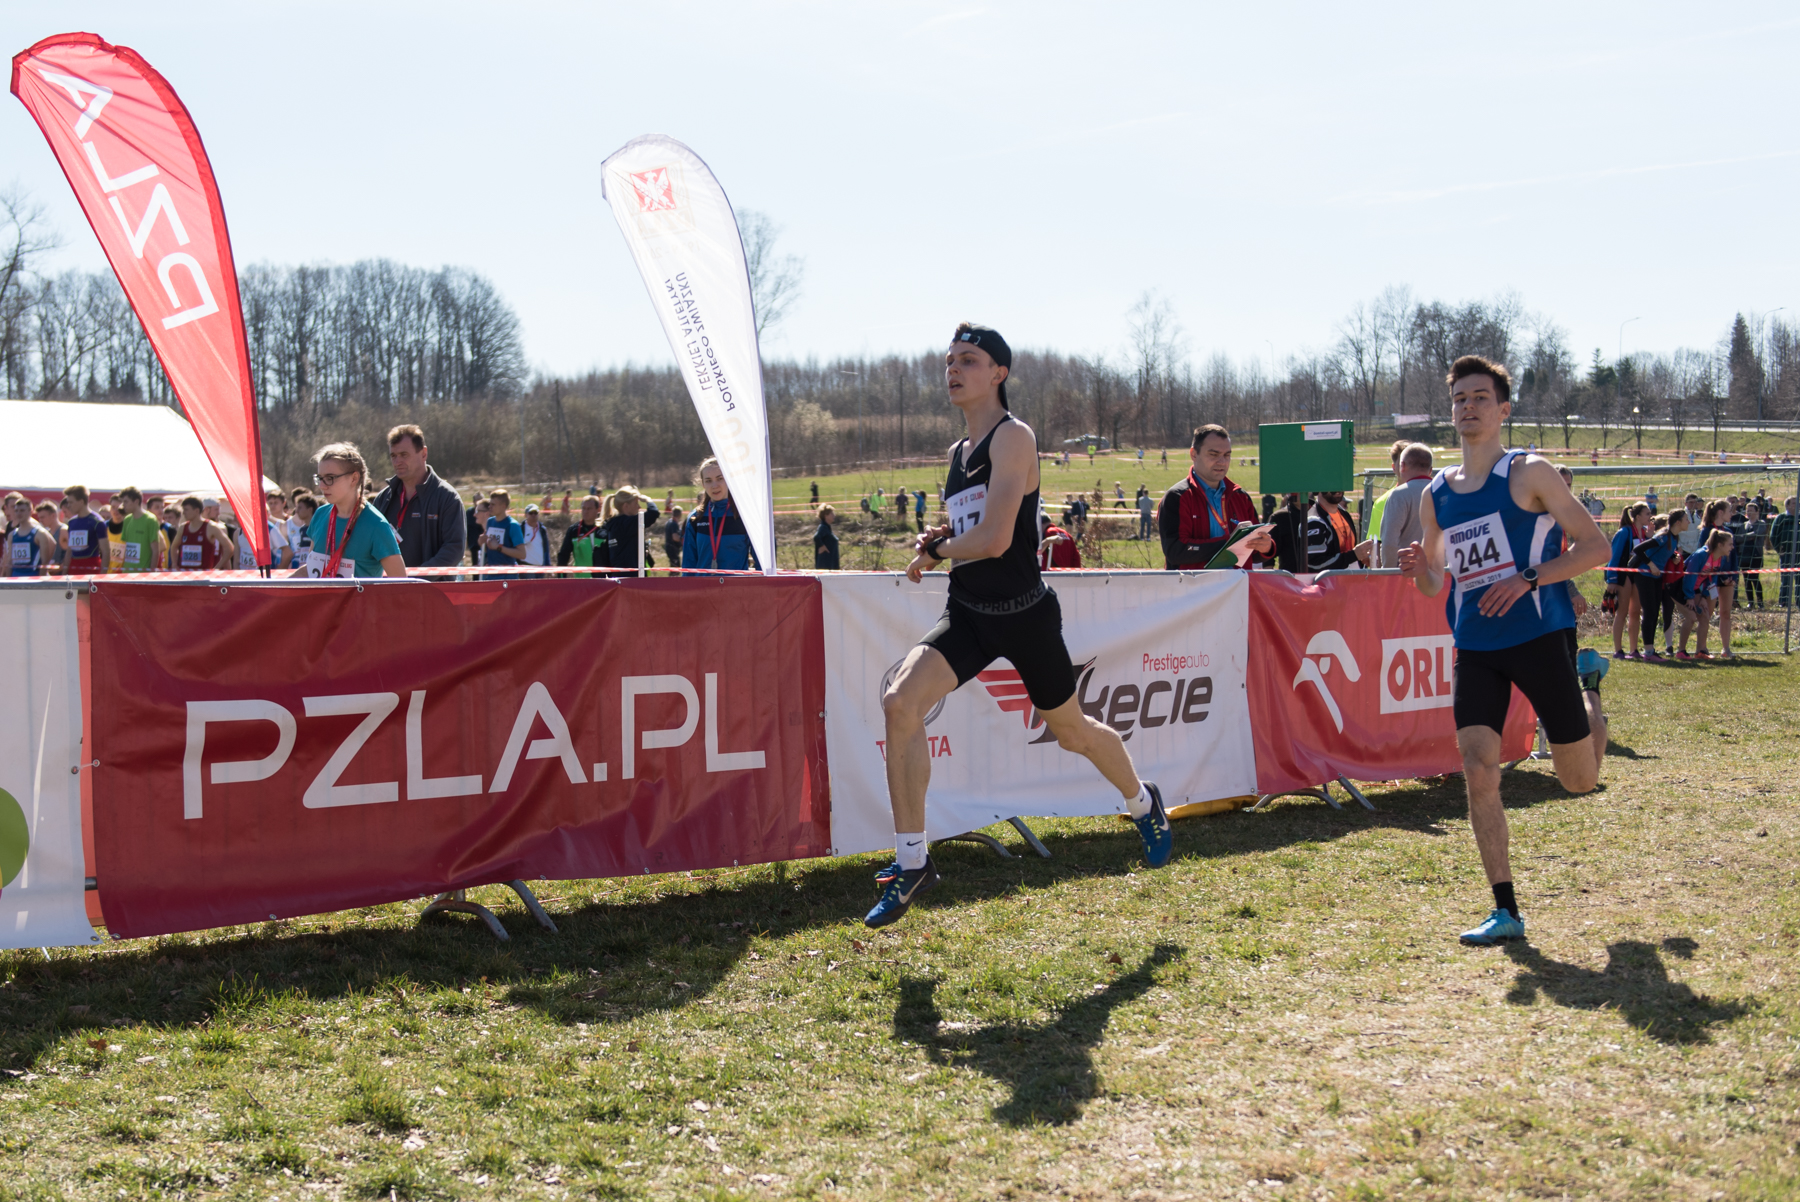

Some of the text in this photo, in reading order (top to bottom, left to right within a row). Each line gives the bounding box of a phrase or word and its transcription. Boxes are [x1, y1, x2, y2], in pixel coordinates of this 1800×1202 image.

[1454, 537, 1501, 574] 244
[982, 601, 1011, 612] PRO
[1014, 587, 1043, 610] NIKE
[1142, 651, 1210, 674] Prestigeauto
[1387, 646, 1456, 702] ORL
[183, 671, 767, 820] PZLA.PL
[876, 735, 952, 761] TTA
